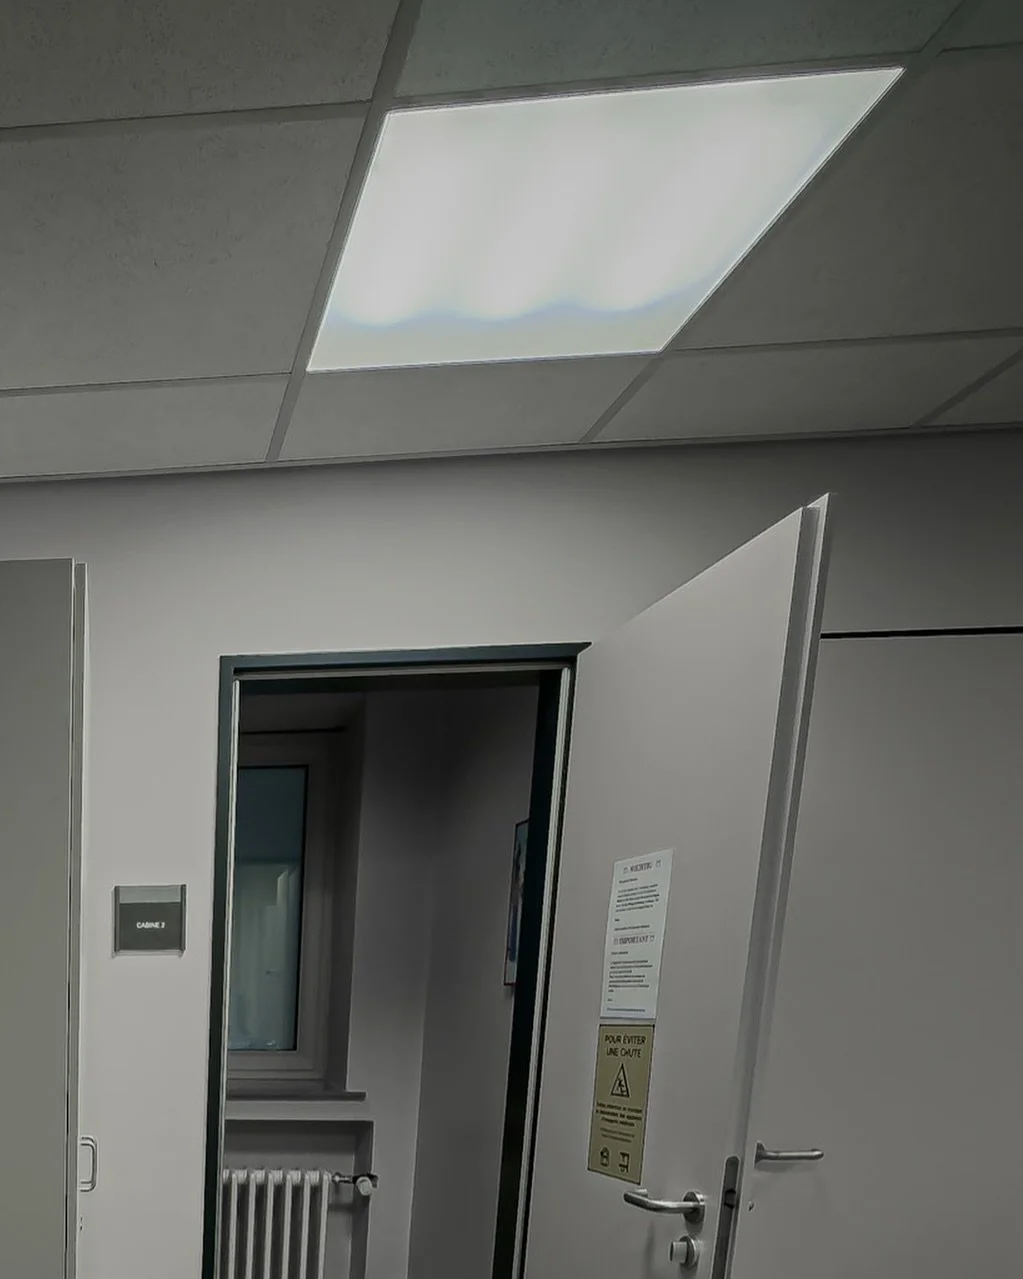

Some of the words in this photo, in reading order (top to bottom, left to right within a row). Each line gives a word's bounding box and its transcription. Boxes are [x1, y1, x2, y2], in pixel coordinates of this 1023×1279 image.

[605, 1034, 622, 1044] POUR
[623, 1033, 646, 1045] ÉVITER
[607, 1047, 619, 1057] UNE
[620, 1047, 642, 1058] CHUTE
